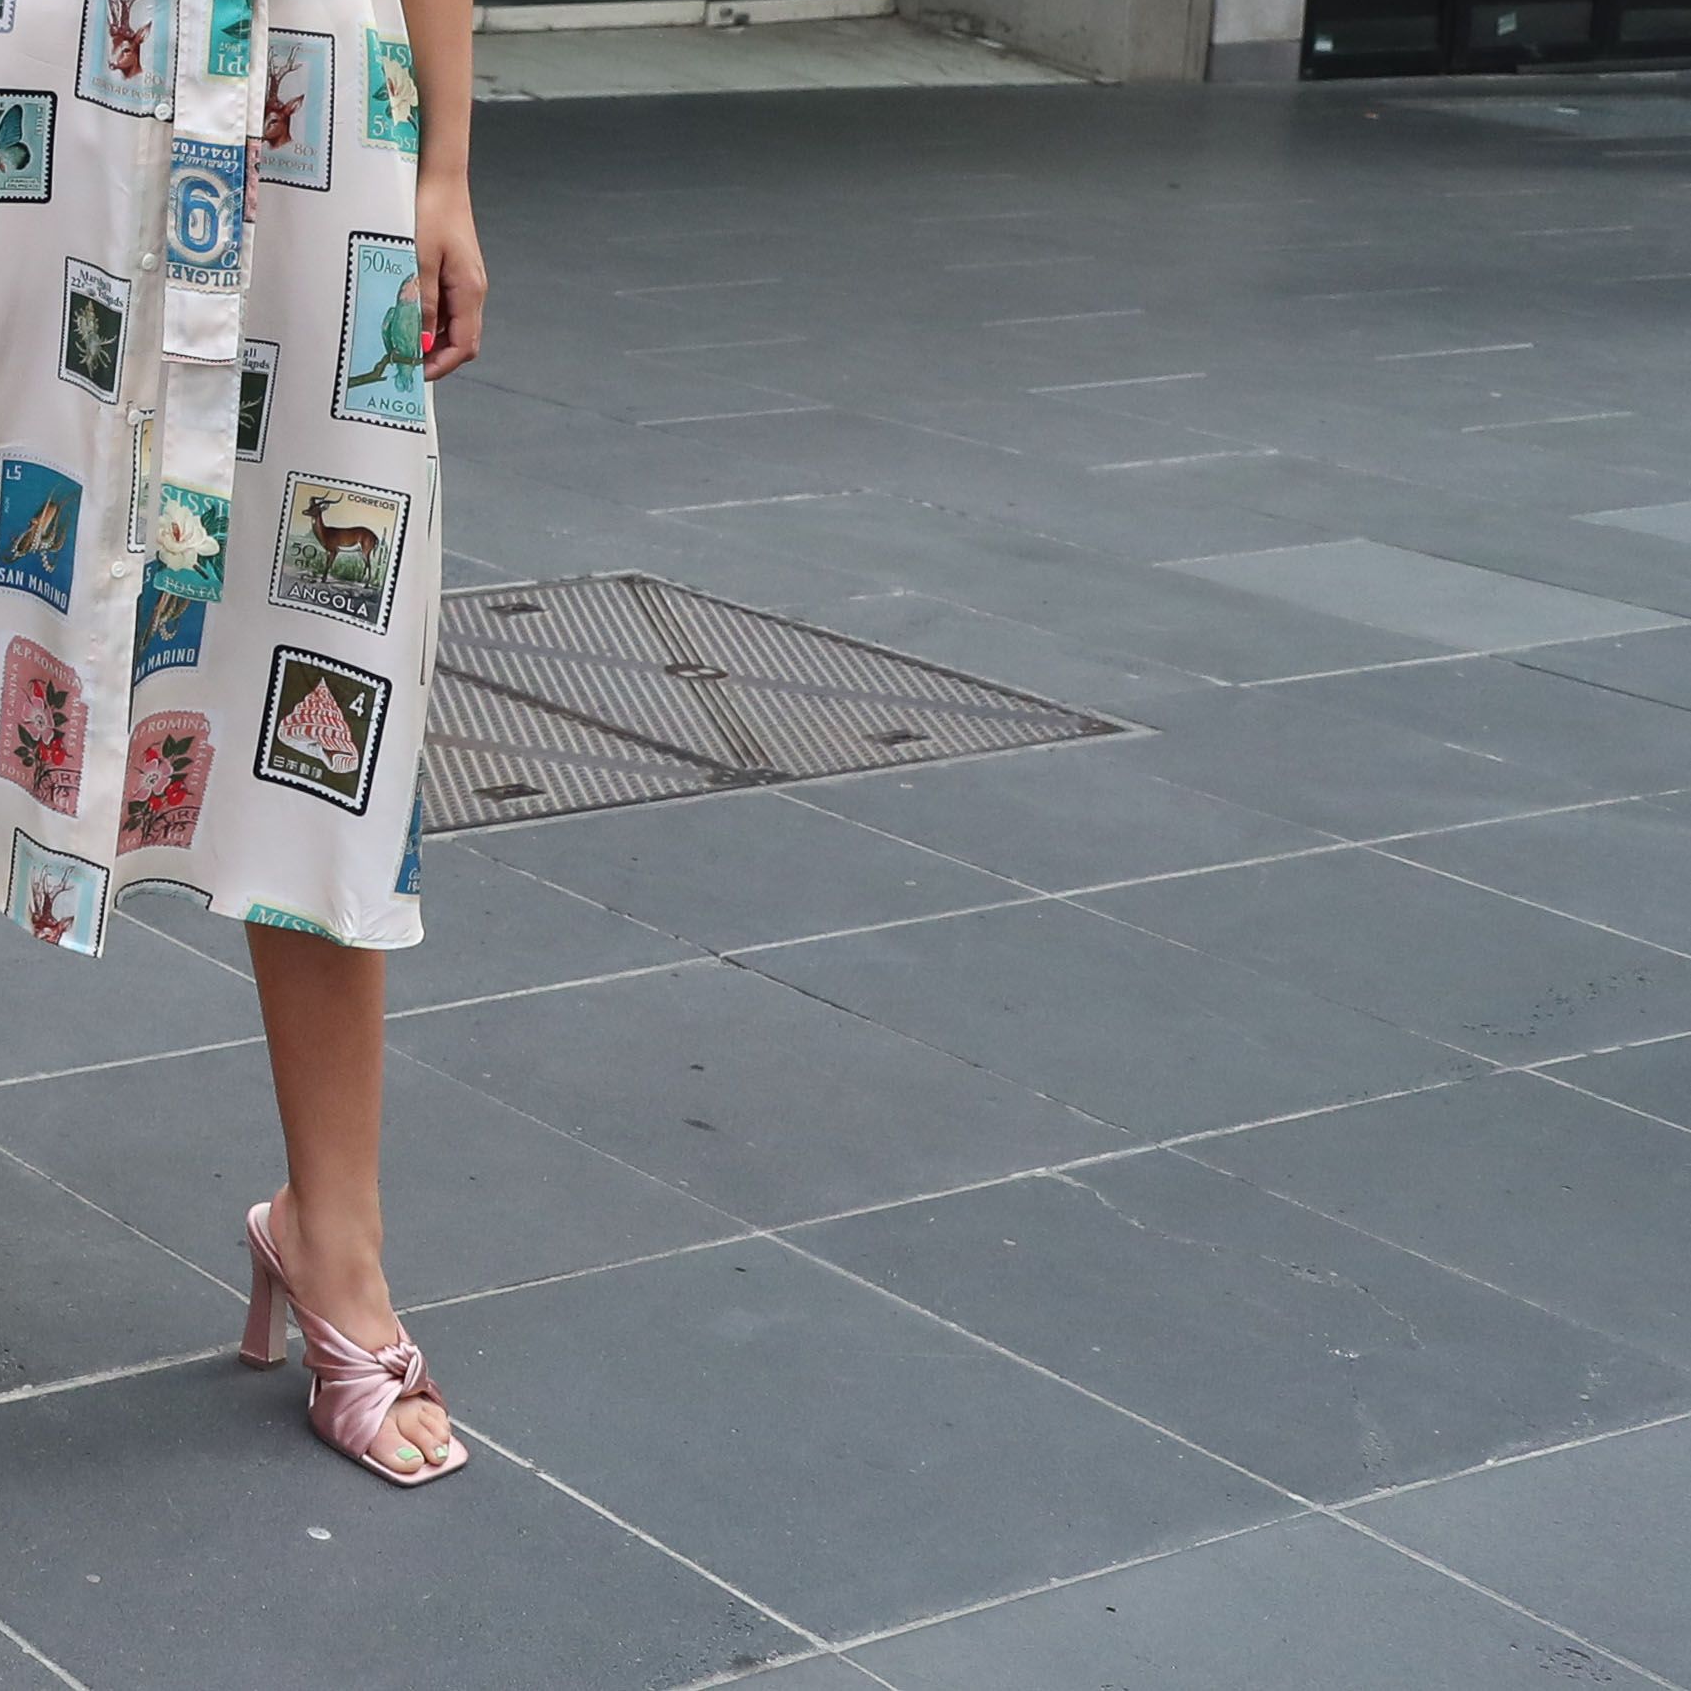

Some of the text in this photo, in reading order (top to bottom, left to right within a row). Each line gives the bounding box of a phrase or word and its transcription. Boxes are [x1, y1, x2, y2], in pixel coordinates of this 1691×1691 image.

[292, 142, 317, 157] 80
[275, 158, 315, 172] POSTA
[362, 251, 384, 273] 50
[347, 493, 396, 511] CORREIOS
[290, 541, 318, 559] 50
[27, 573, 69, 610] MARINO
[288, 582, 369, 618] ANGOLA
[147, 647, 196, 671] MARINO
[6, 662, 19, 718] CANINA
[348, 691, 366, 717] 4
